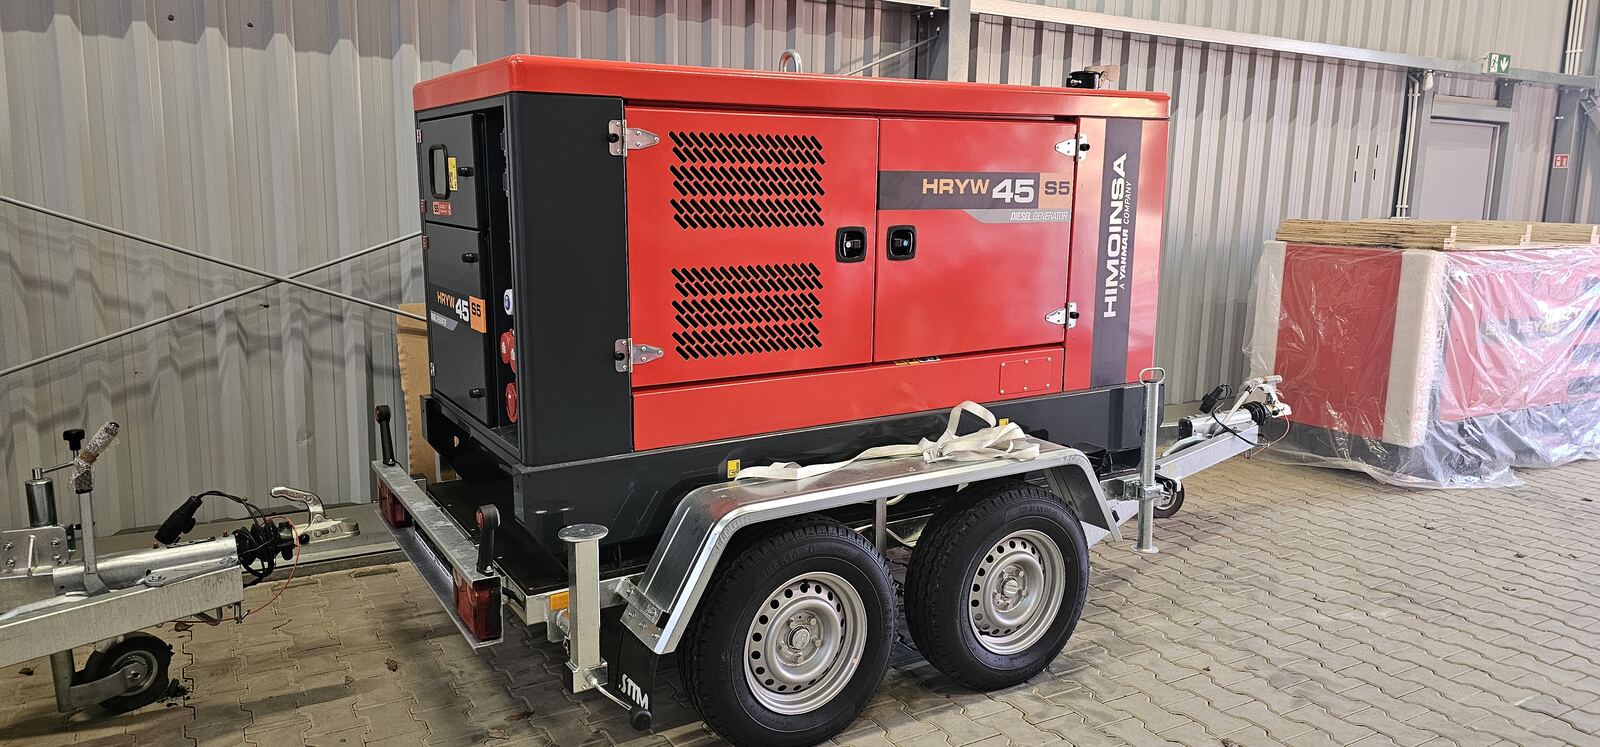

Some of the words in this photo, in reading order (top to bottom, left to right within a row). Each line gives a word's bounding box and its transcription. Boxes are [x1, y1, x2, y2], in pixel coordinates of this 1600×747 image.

[922, 178, 990, 194] HRYW
[992, 178, 1035, 203] 45
[1045, 181, 1070, 196] S5
[1123, 181, 1132, 224] COMPANY
[1011, 211, 1031, 221] DIESEL
[1032, 211, 1068, 221] GENERATOR
[1103, 153, 1127, 318] HIMOINSA
[1119, 229, 1129, 280] YANMAR
[437, 291, 455, 309] HRYW
[456, 298, 469, 322] 45
[471, 302, 482, 317] S5
